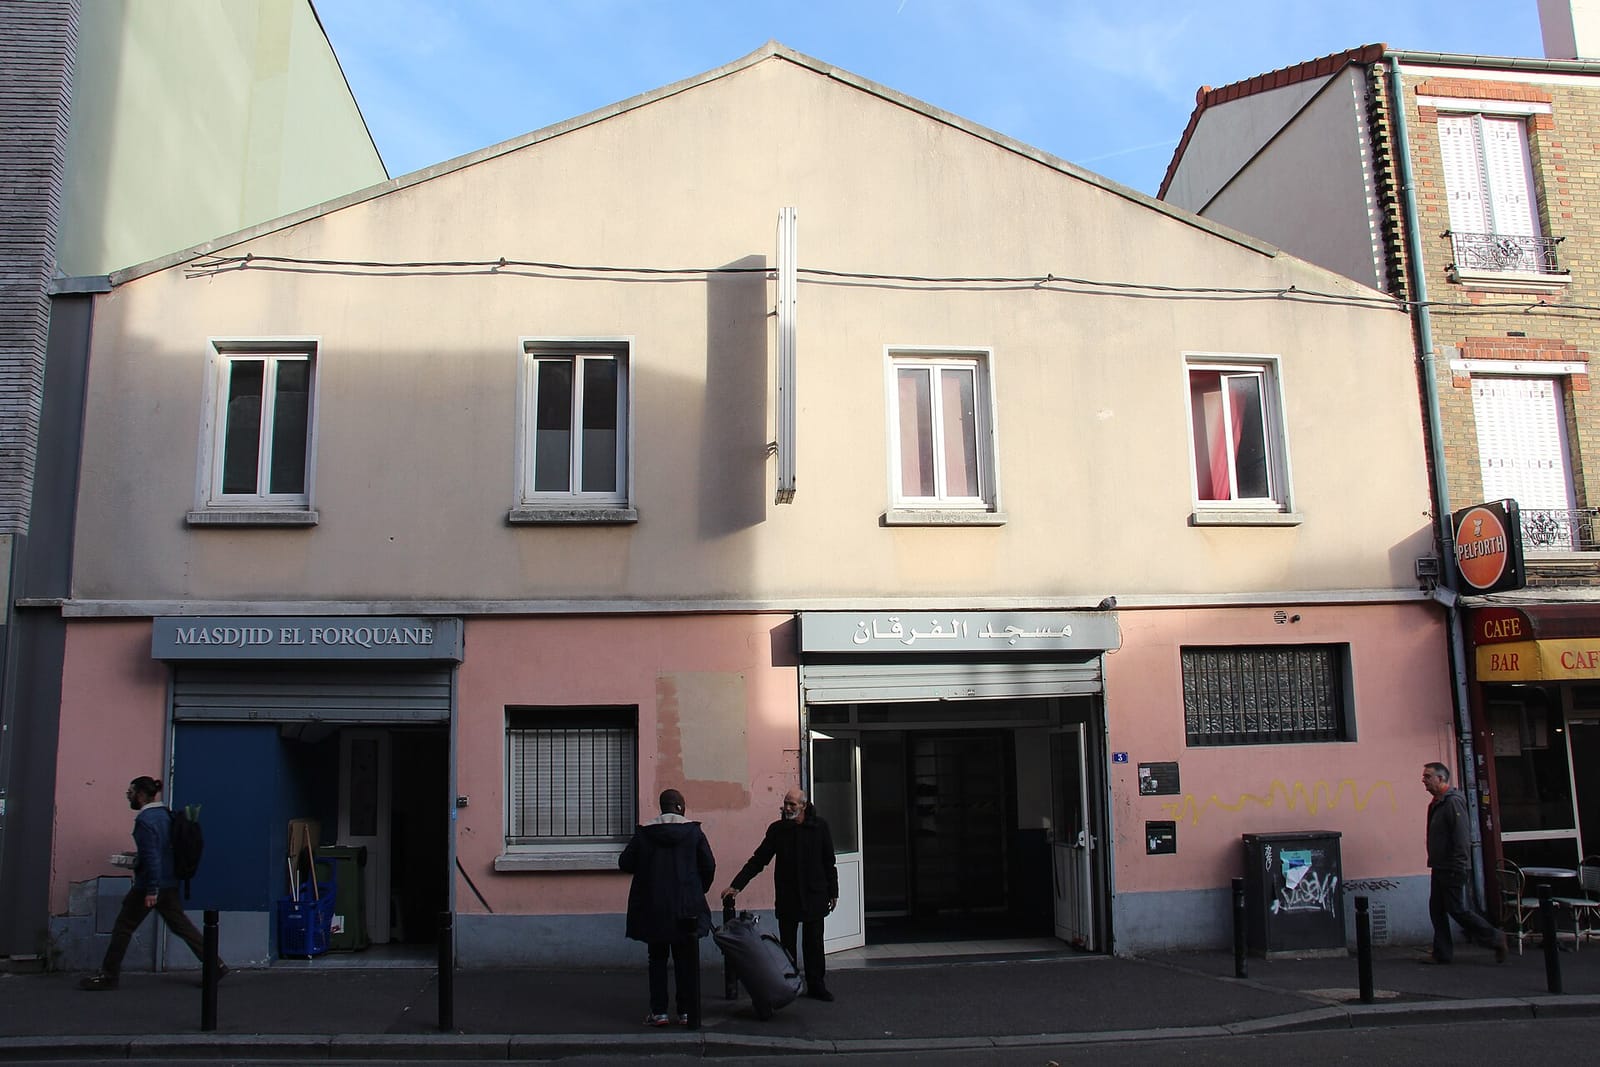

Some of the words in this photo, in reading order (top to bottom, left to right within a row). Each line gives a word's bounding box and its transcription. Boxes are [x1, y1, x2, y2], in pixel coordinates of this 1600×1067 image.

[1458, 535, 1504, 561] PELFORTH
[174, 627, 273, 648] MASDJID
[279, 627, 305, 646] EL
[310, 627, 434, 648] FORQUANE
[852, 616, 968, 645] الفرقان
[977, 621, 1073, 645] مسجد
[1484, 617, 1521, 639] CAFE
[1490, 653, 1520, 672] BAR
[1560, 651, 1600, 670] CAF
[1117, 754, 1123, 762] 3
